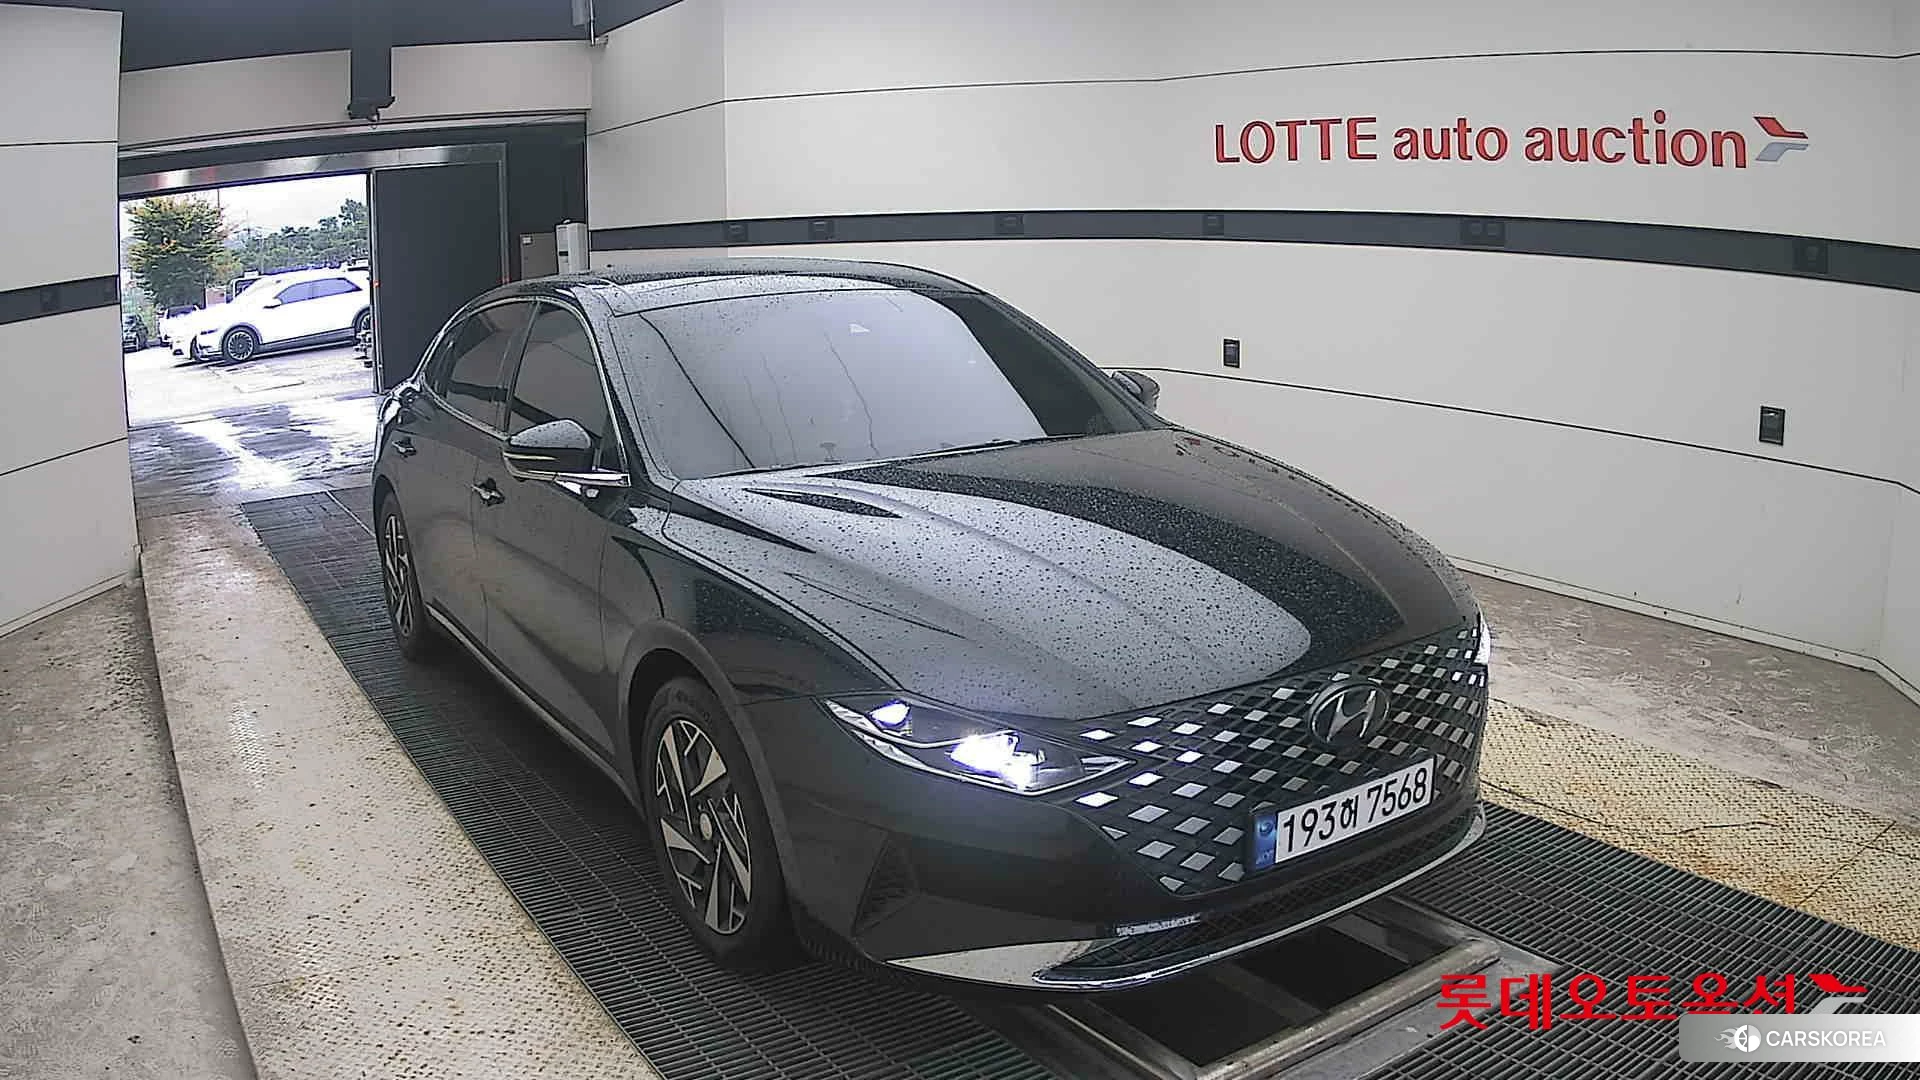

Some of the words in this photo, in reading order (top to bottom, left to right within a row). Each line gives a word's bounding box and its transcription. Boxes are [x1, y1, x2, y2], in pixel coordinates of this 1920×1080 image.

[1215, 117, 1377, 162] LOTTE
[1393, 118, 1508, 161] auto
[1524, 110, 1747, 168] auction
[1284, 795, 1359, 852] 193허
[1367, 768, 1428, 823] 7568
